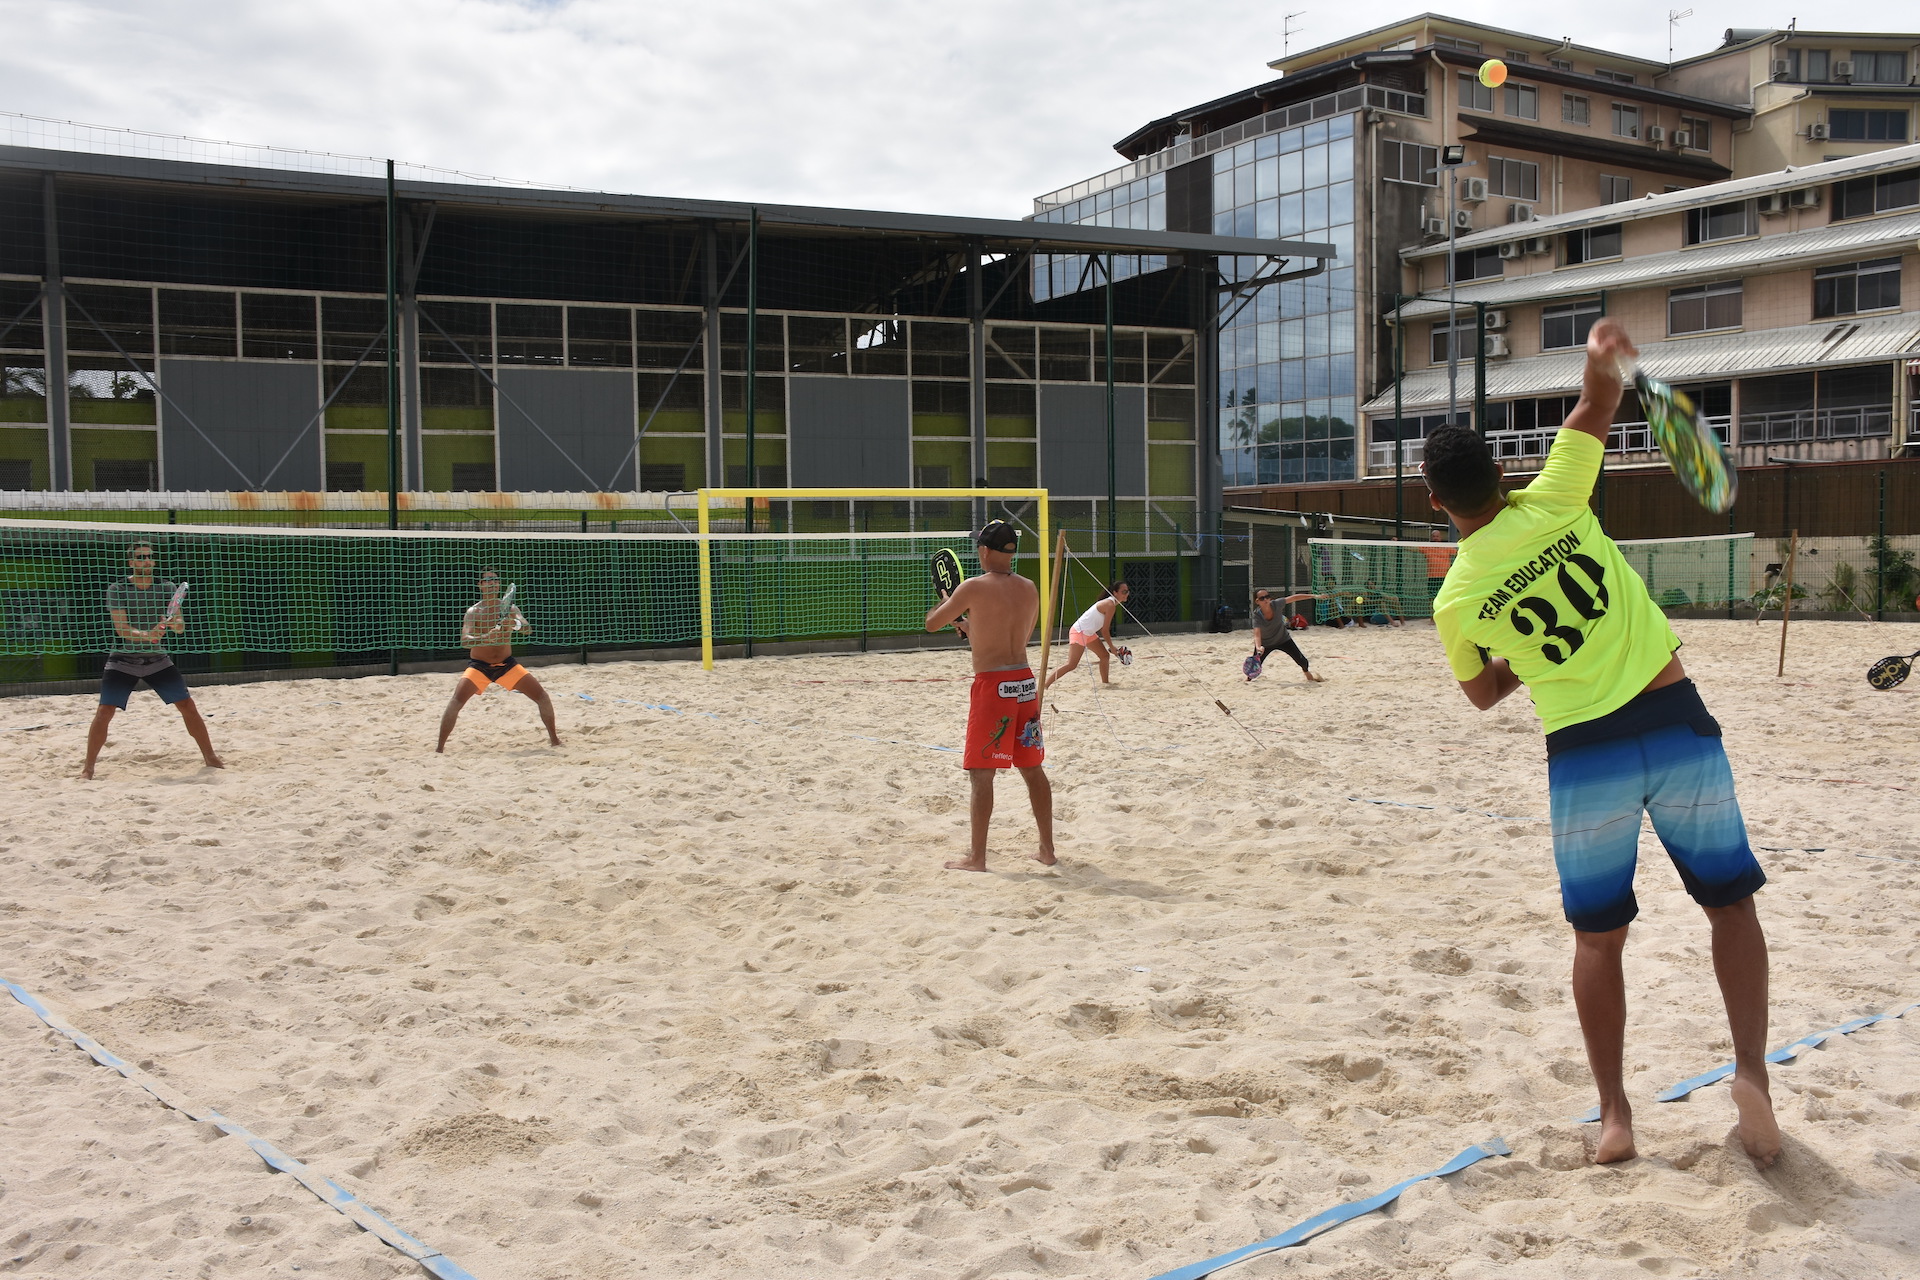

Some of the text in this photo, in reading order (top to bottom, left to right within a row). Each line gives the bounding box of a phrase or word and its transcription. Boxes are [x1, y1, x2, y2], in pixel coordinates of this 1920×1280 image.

[1478, 530, 1581, 621] TEAM EDUCATION
[1511, 553, 1609, 665] 30
